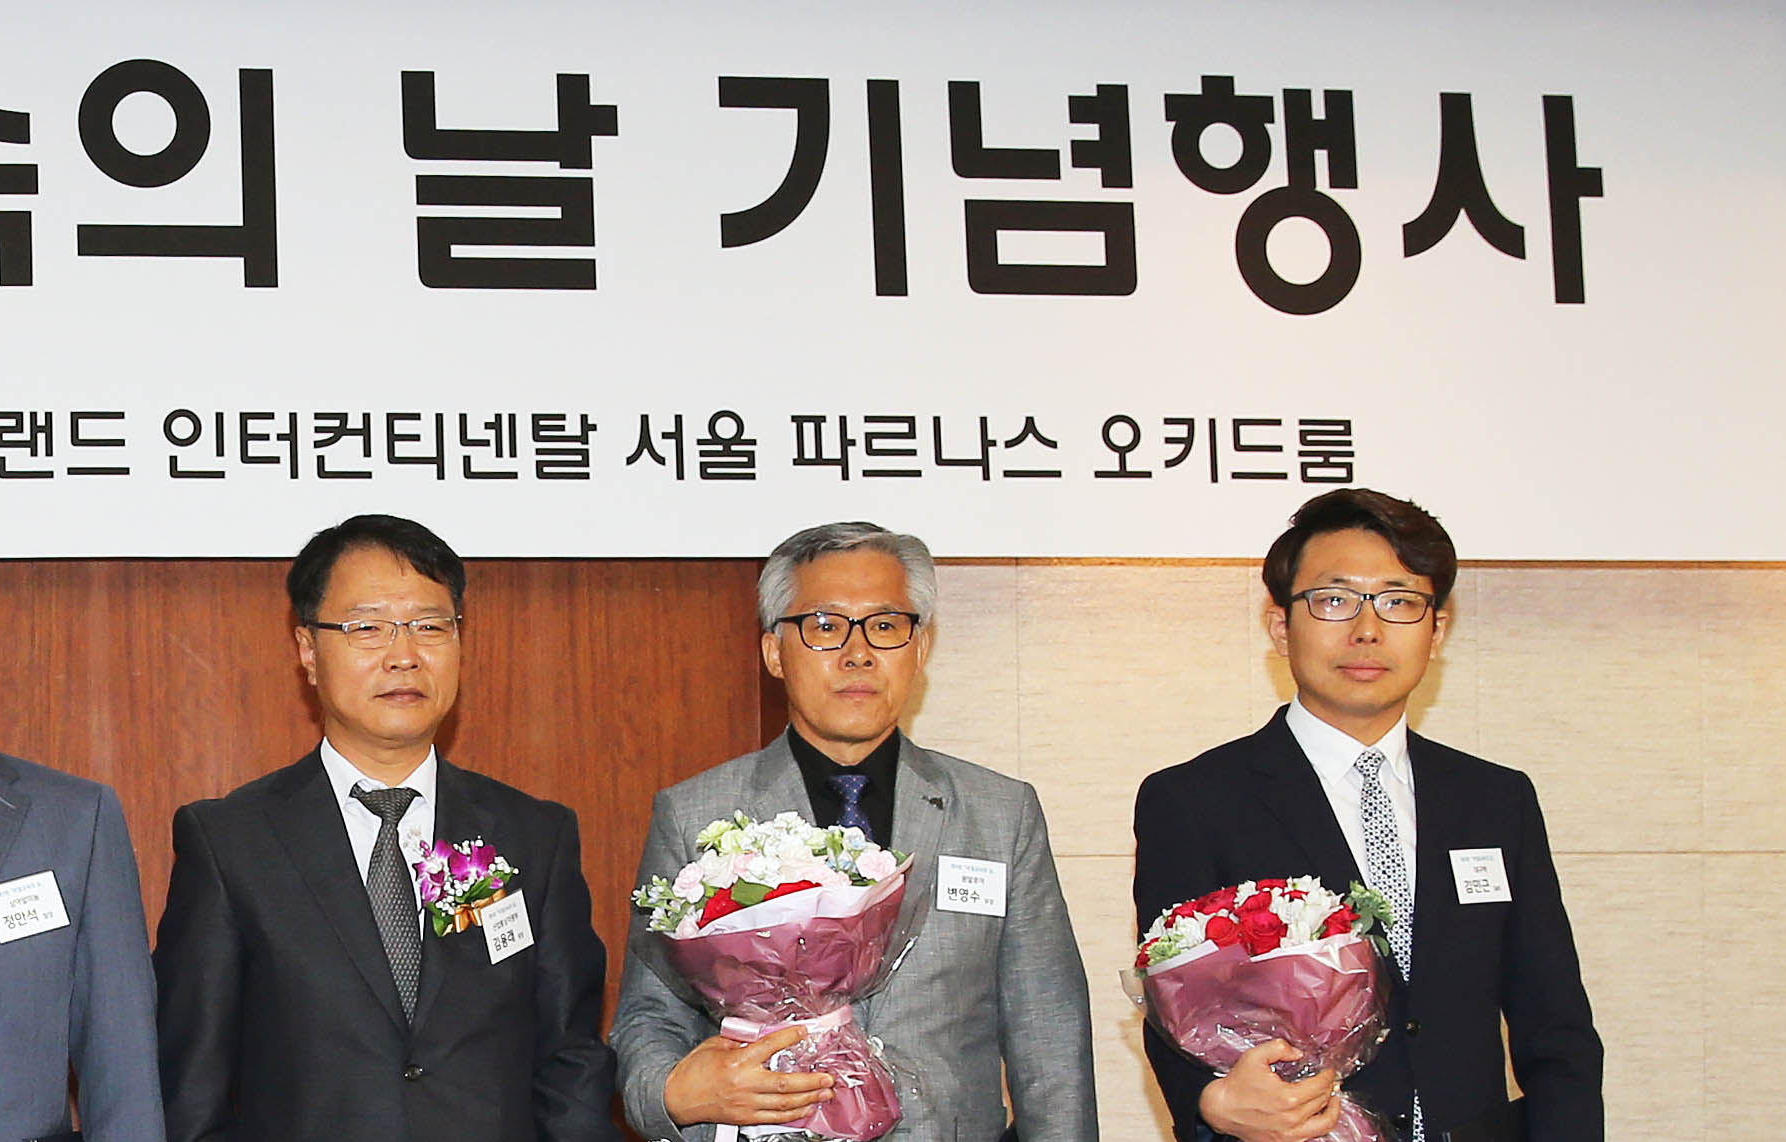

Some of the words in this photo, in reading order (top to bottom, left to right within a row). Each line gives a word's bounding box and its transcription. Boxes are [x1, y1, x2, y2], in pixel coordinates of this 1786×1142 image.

[400, 70, 618, 290] 날
[718, 74, 1603, 315] 기념행사
[163, 408, 597, 480] 인터컨티넨탈
[626, 409, 756, 480] 서울
[790, 414, 1061, 480] 파르나스
[1094, 414, 1356, 484] 오키드룸
[2, 907, 39, 930] 정만석
[947, 887, 980, 903] 변영수
